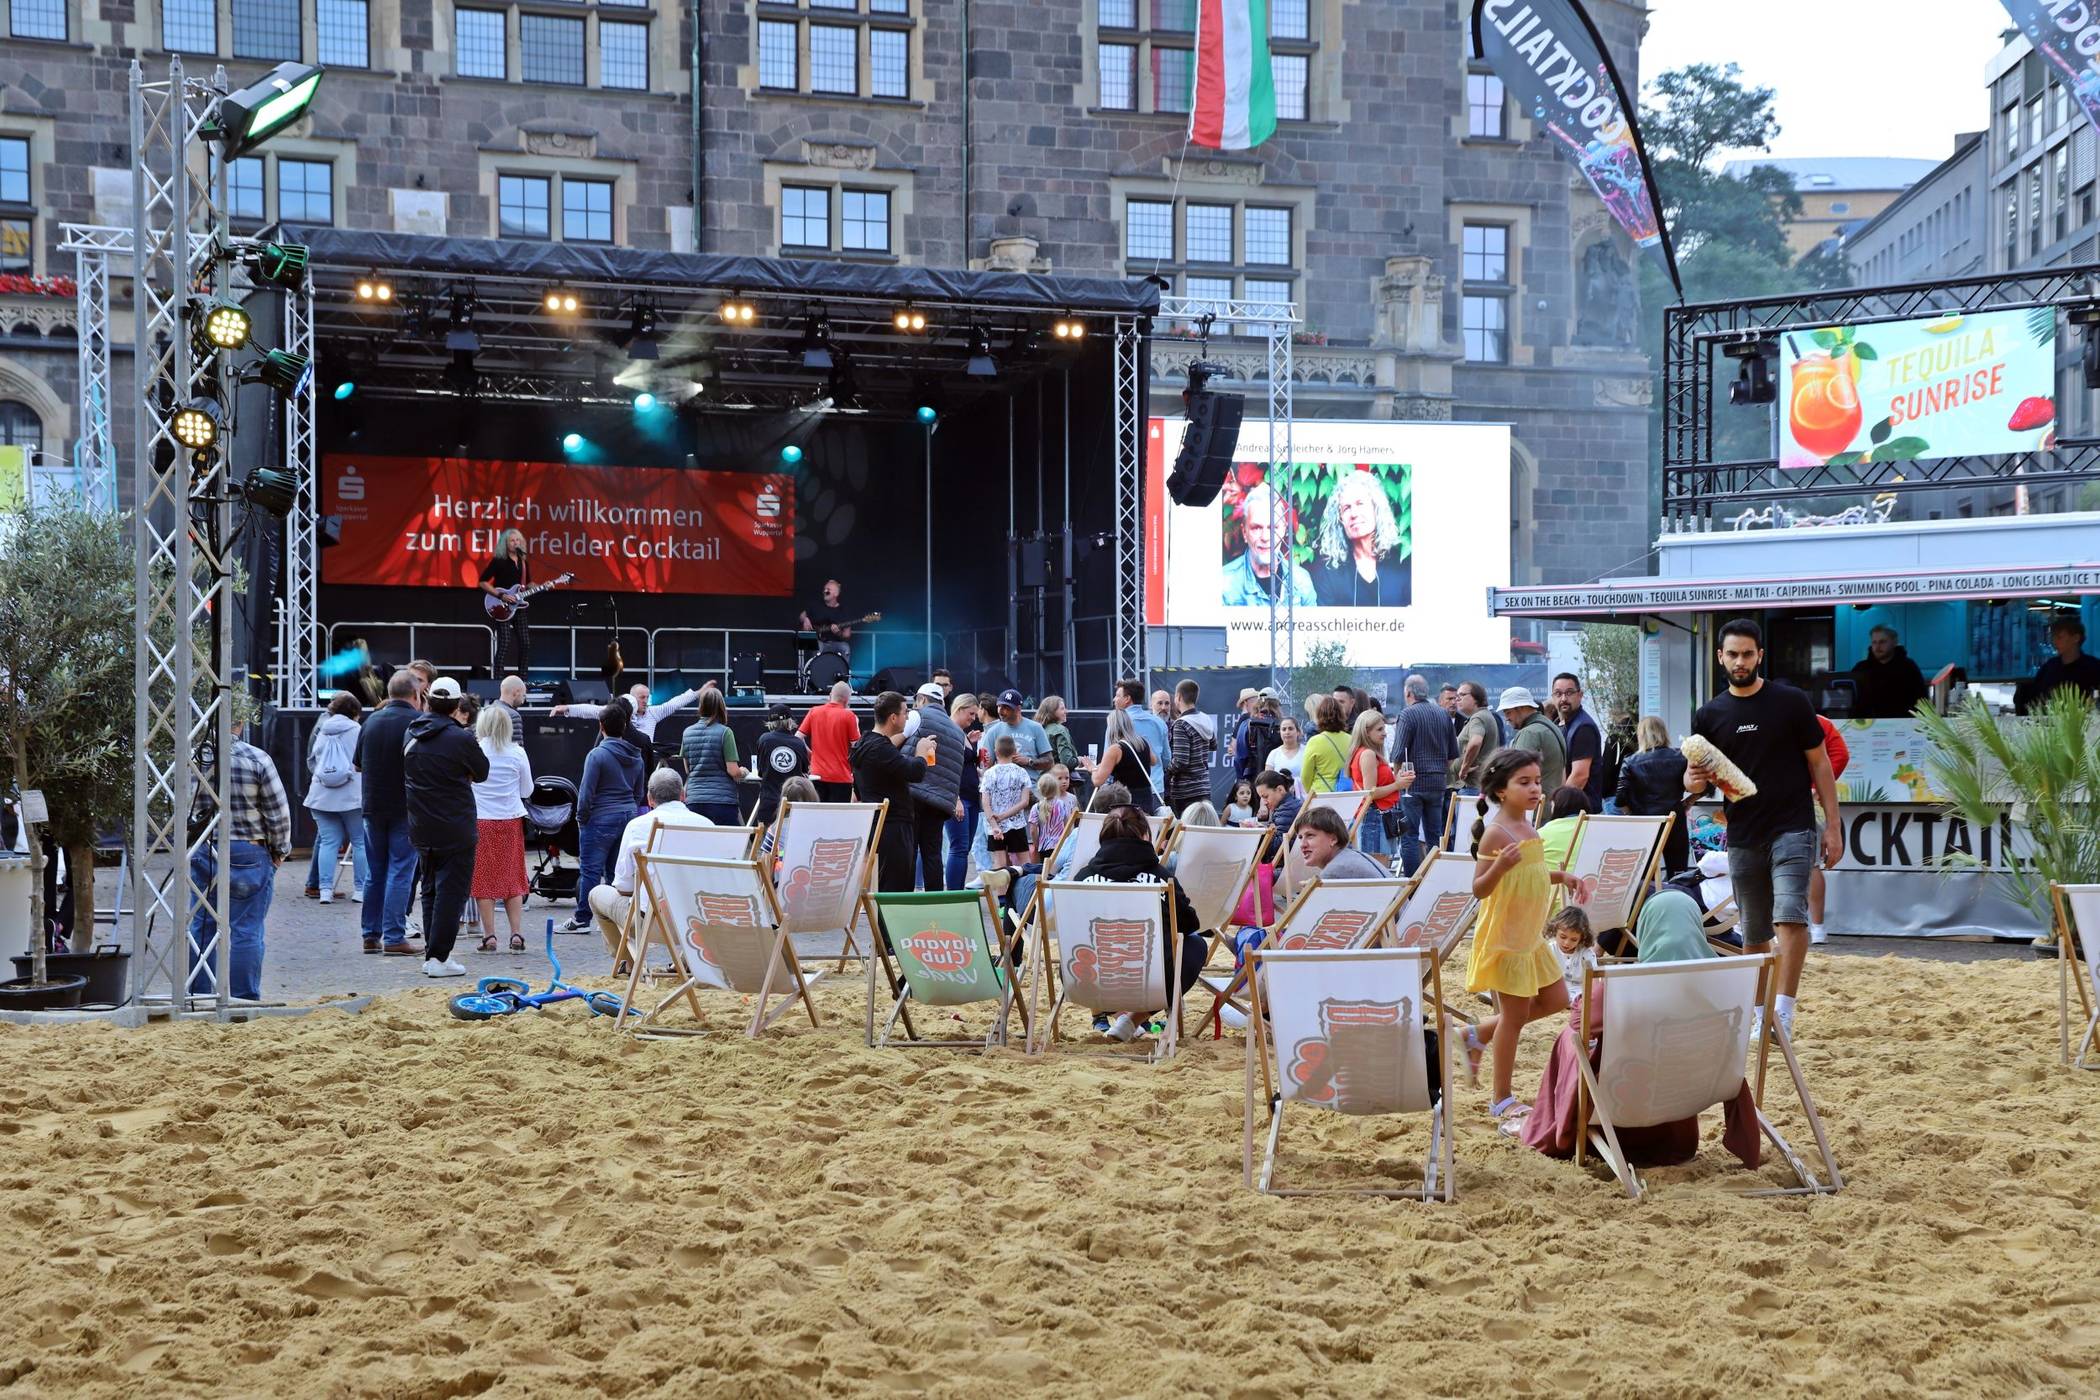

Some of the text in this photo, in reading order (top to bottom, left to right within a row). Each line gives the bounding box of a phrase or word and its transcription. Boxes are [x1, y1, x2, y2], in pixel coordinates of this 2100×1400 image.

[1887, 327, 1995, 388] TEQUILA
[1889, 363, 2006, 427] SUNRISE
[434, 494, 703, 527] Herzlich willkommen
[406, 528, 721, 560] zum Elrfelder Cocktail
[1505, 597, 1520, 607] SEX
[1521, 596, 1533, 607] ON
[1535, 596, 1551, 606] THE
[1553, 594, 1580, 606] BEACH
[1587, 592, 1643, 605] TOUCHDOWN
[1650, 590, 1687, 602] TEQUILA
[1689, 589, 1727, 601] SUNRISE
[1735, 588, 1752, 599] MAI
[1755, 587, 1769, 598] TAI
[1776, 585, 1831, 597] CAIPIRINHA
[1839, 582, 1892, 595] SWIMMING
[1895, 580, 1920, 592] POOL
[1929, 579, 1952, 590] PINA
[1955, 577, 1993, 590] COLADA
[2003, 575, 2029, 587] LONG
[2032, 574, 2070, 586] ISLAND
[2073, 573, 2089, 585] ICE
